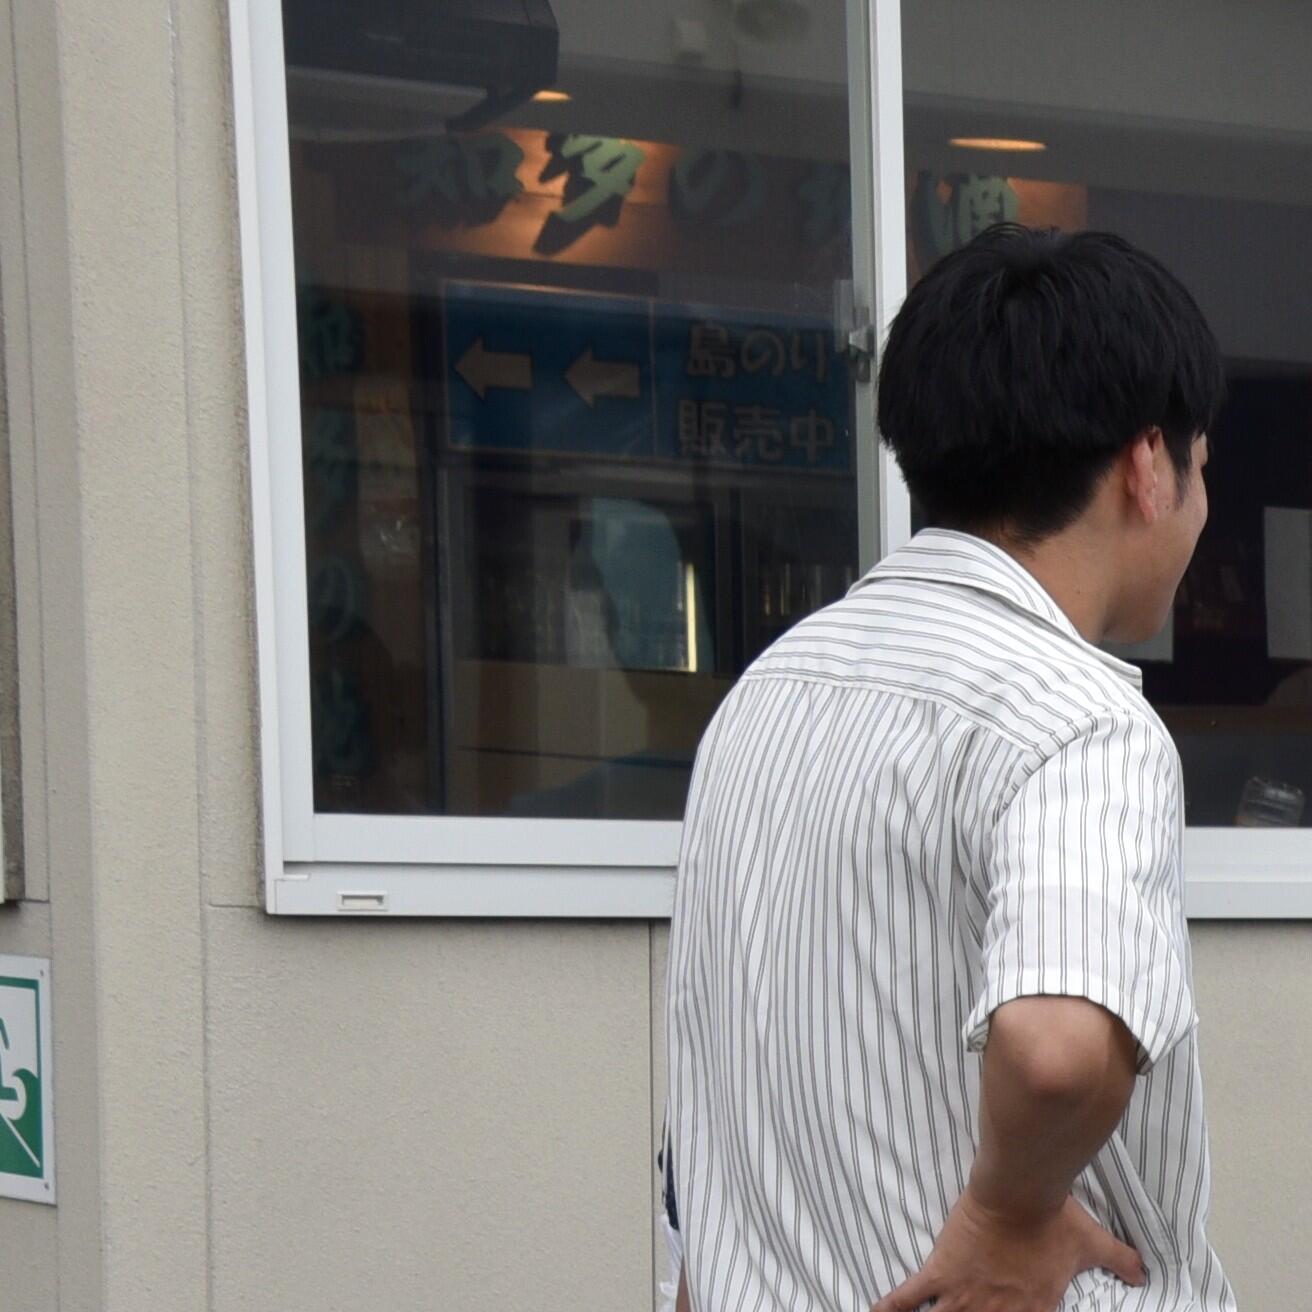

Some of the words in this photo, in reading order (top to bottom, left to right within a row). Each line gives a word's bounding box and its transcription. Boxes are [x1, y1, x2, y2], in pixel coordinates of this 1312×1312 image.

[687, 322, 827, 382] 島のり
[678, 399, 836, 464] 販売中
